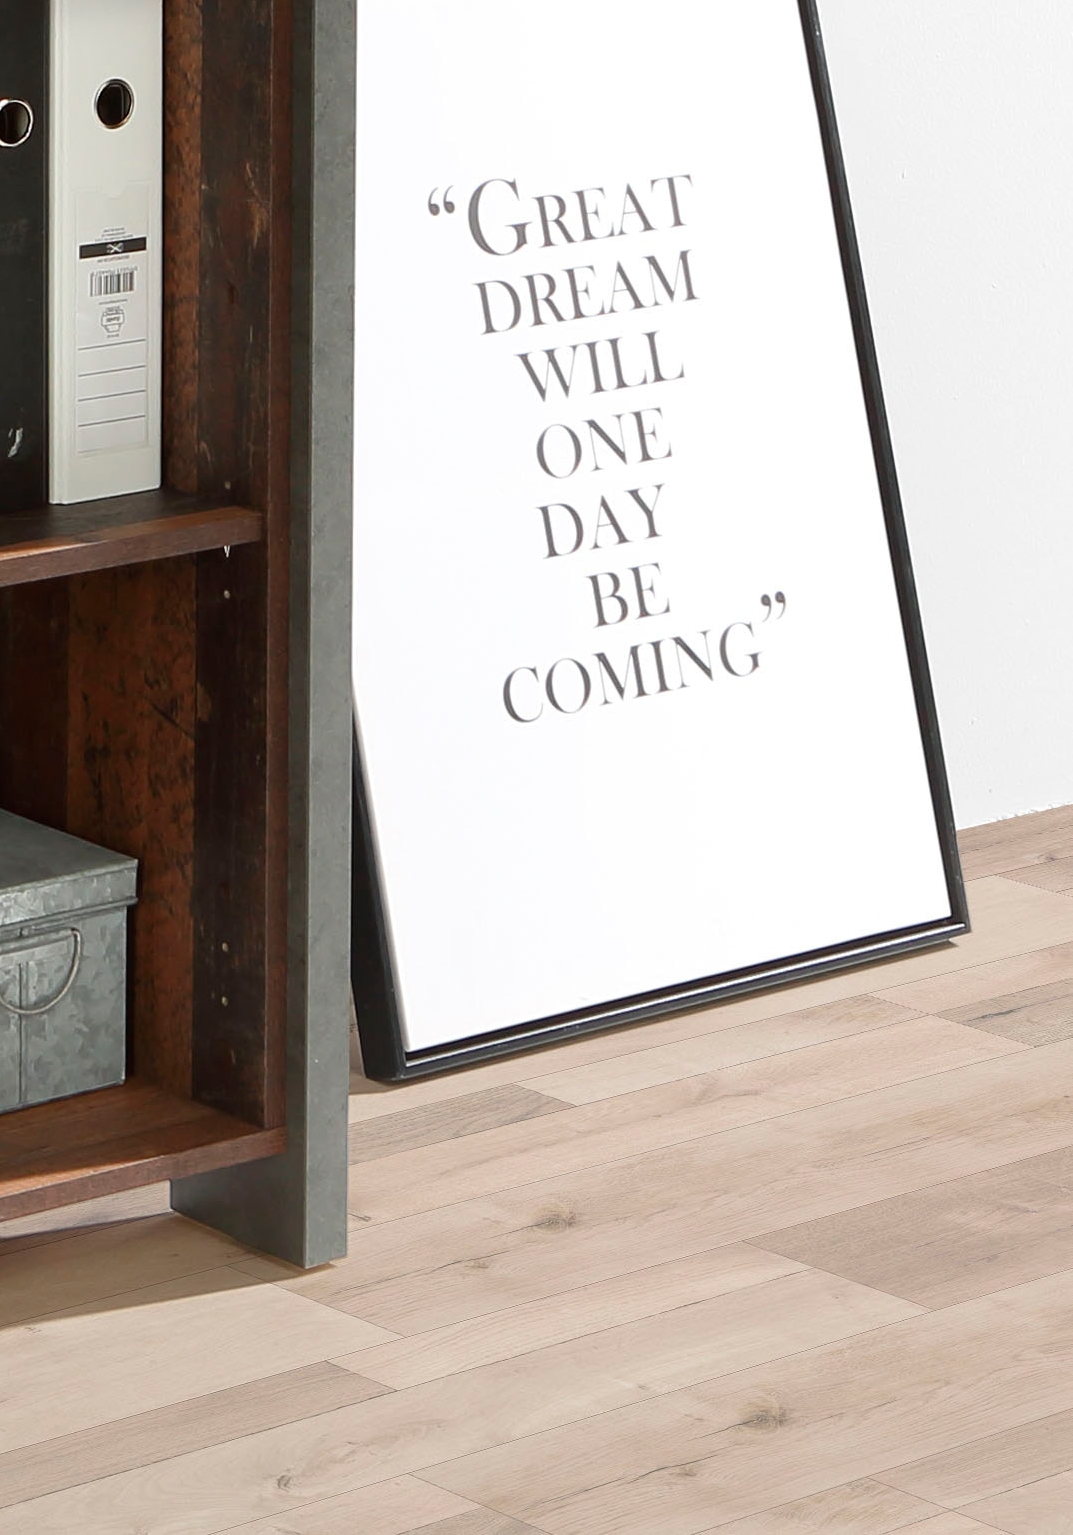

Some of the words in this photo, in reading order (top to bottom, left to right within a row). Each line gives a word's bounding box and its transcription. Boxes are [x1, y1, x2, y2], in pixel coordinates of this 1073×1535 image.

[473, 249, 700, 336] DREAM
[515, 330, 685, 403] WILL
[535, 406, 673, 479] ONE
[535, 483, 665, 560] DAY
[585, 562, 671, 629] BE
